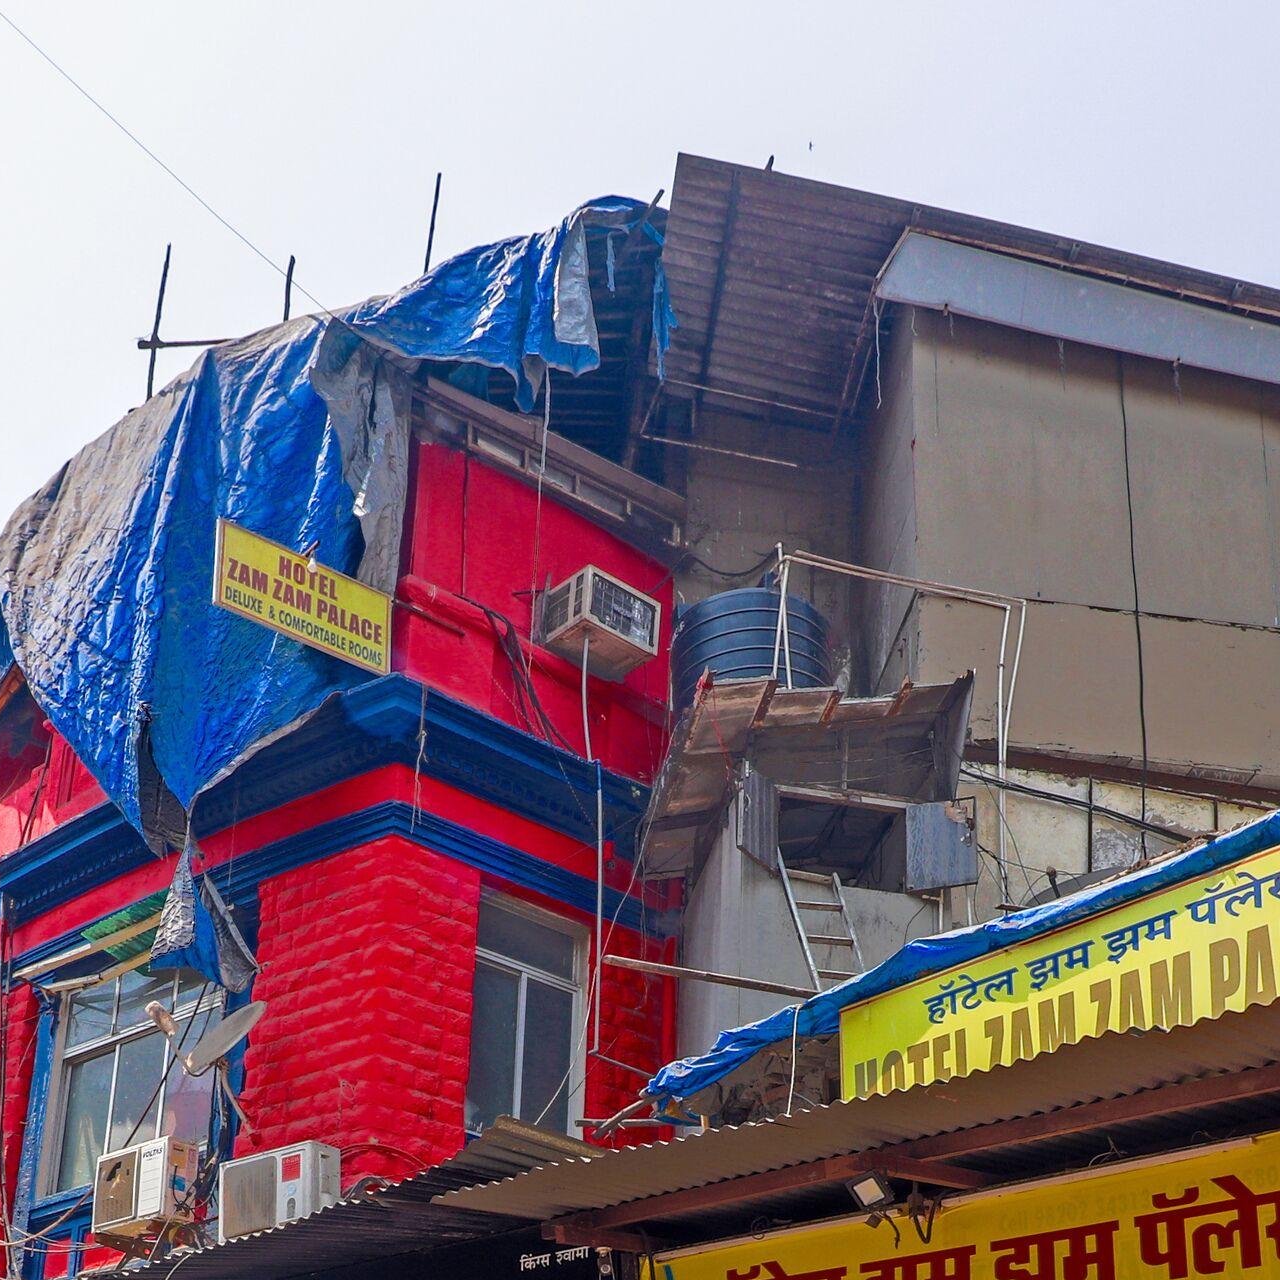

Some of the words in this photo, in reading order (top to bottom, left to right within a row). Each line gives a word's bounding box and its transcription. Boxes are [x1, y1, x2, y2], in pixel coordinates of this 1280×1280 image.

[227, 558, 268, 594] ZAM
[272, 578, 312, 615] ZAM
[316, 598, 382, 645] PALACE
[279, 556, 338, 601] HOTEL
[225, 586, 263, 614] DELUXE
[269, 605, 275, 620] &
[278, 609, 351, 650] COMFORTABLE
[348, 640, 382, 667] ROOMS
[1024, 939, 1096, 992] झम
[1101, 909, 1177, 965] झम
